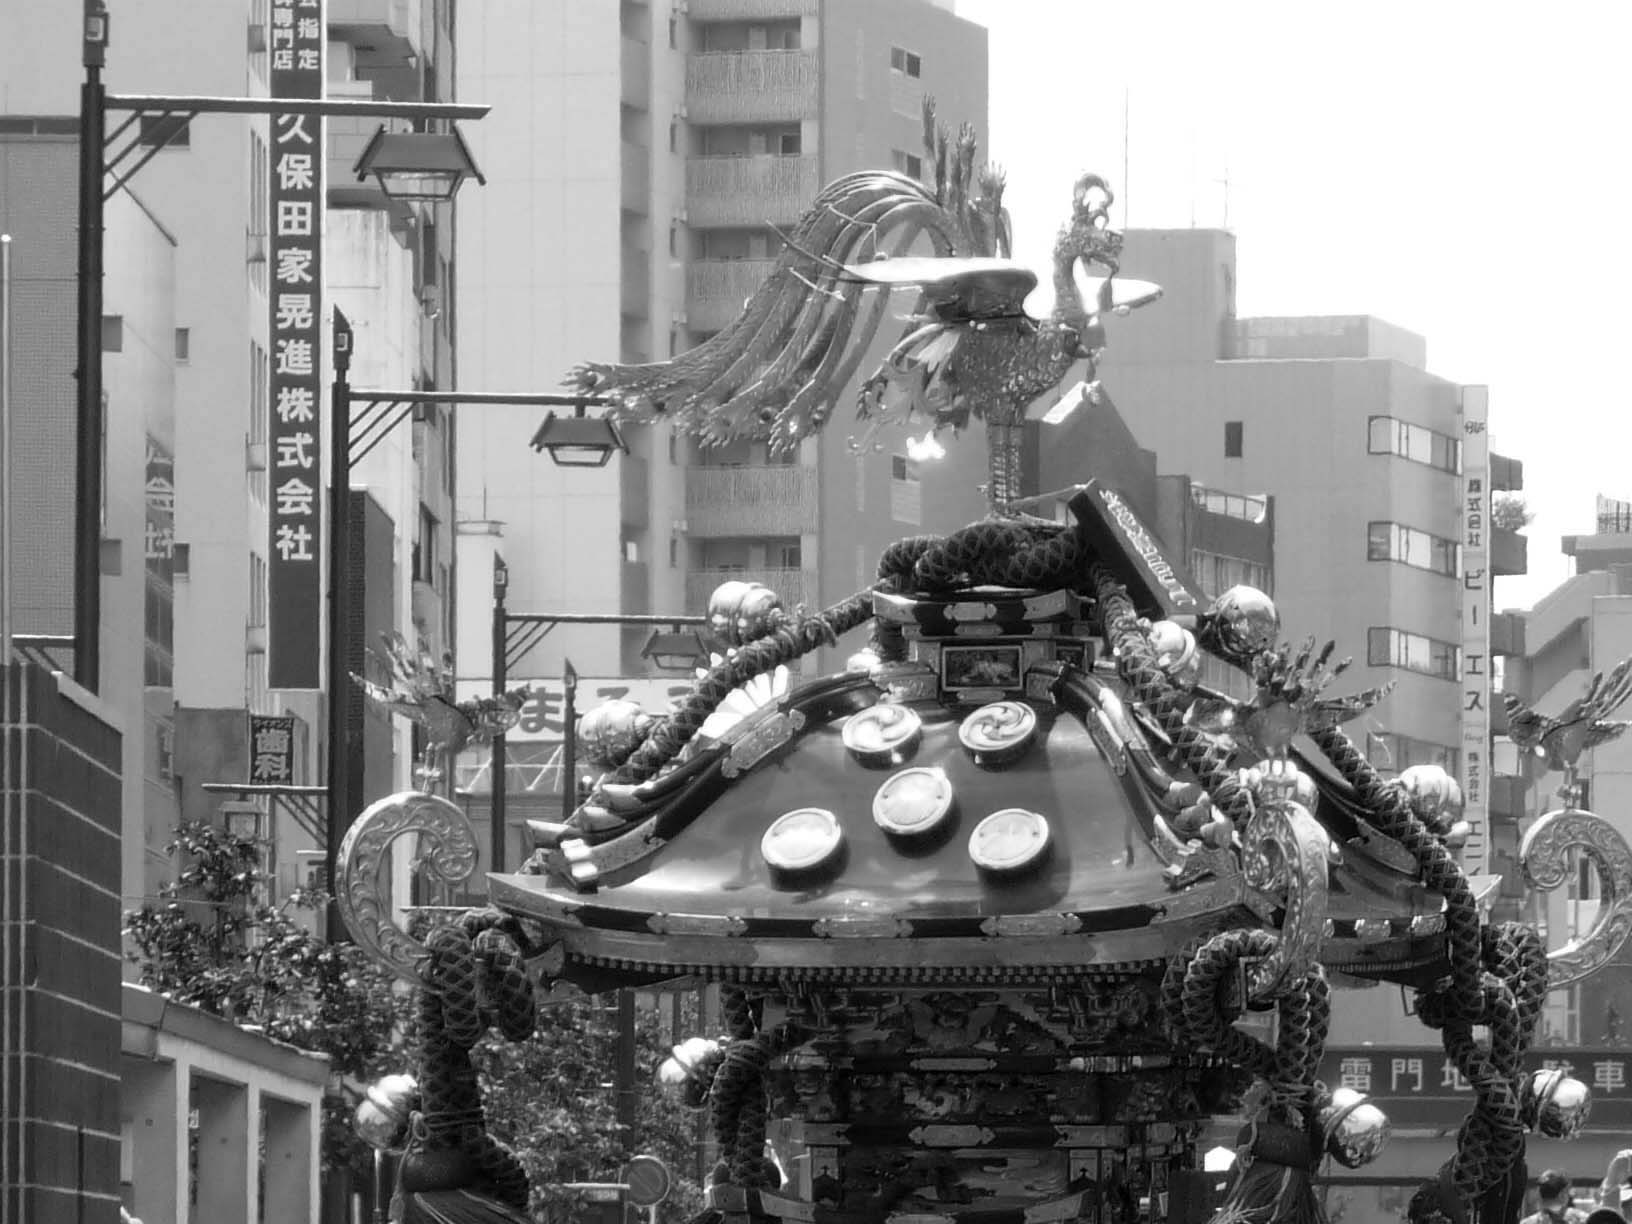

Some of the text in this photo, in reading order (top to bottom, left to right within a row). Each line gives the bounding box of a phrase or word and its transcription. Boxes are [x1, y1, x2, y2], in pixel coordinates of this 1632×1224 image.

[276, 113, 314, 560] 久保田家晃進株式会社
[255, 728, 290, 779] 歯科
